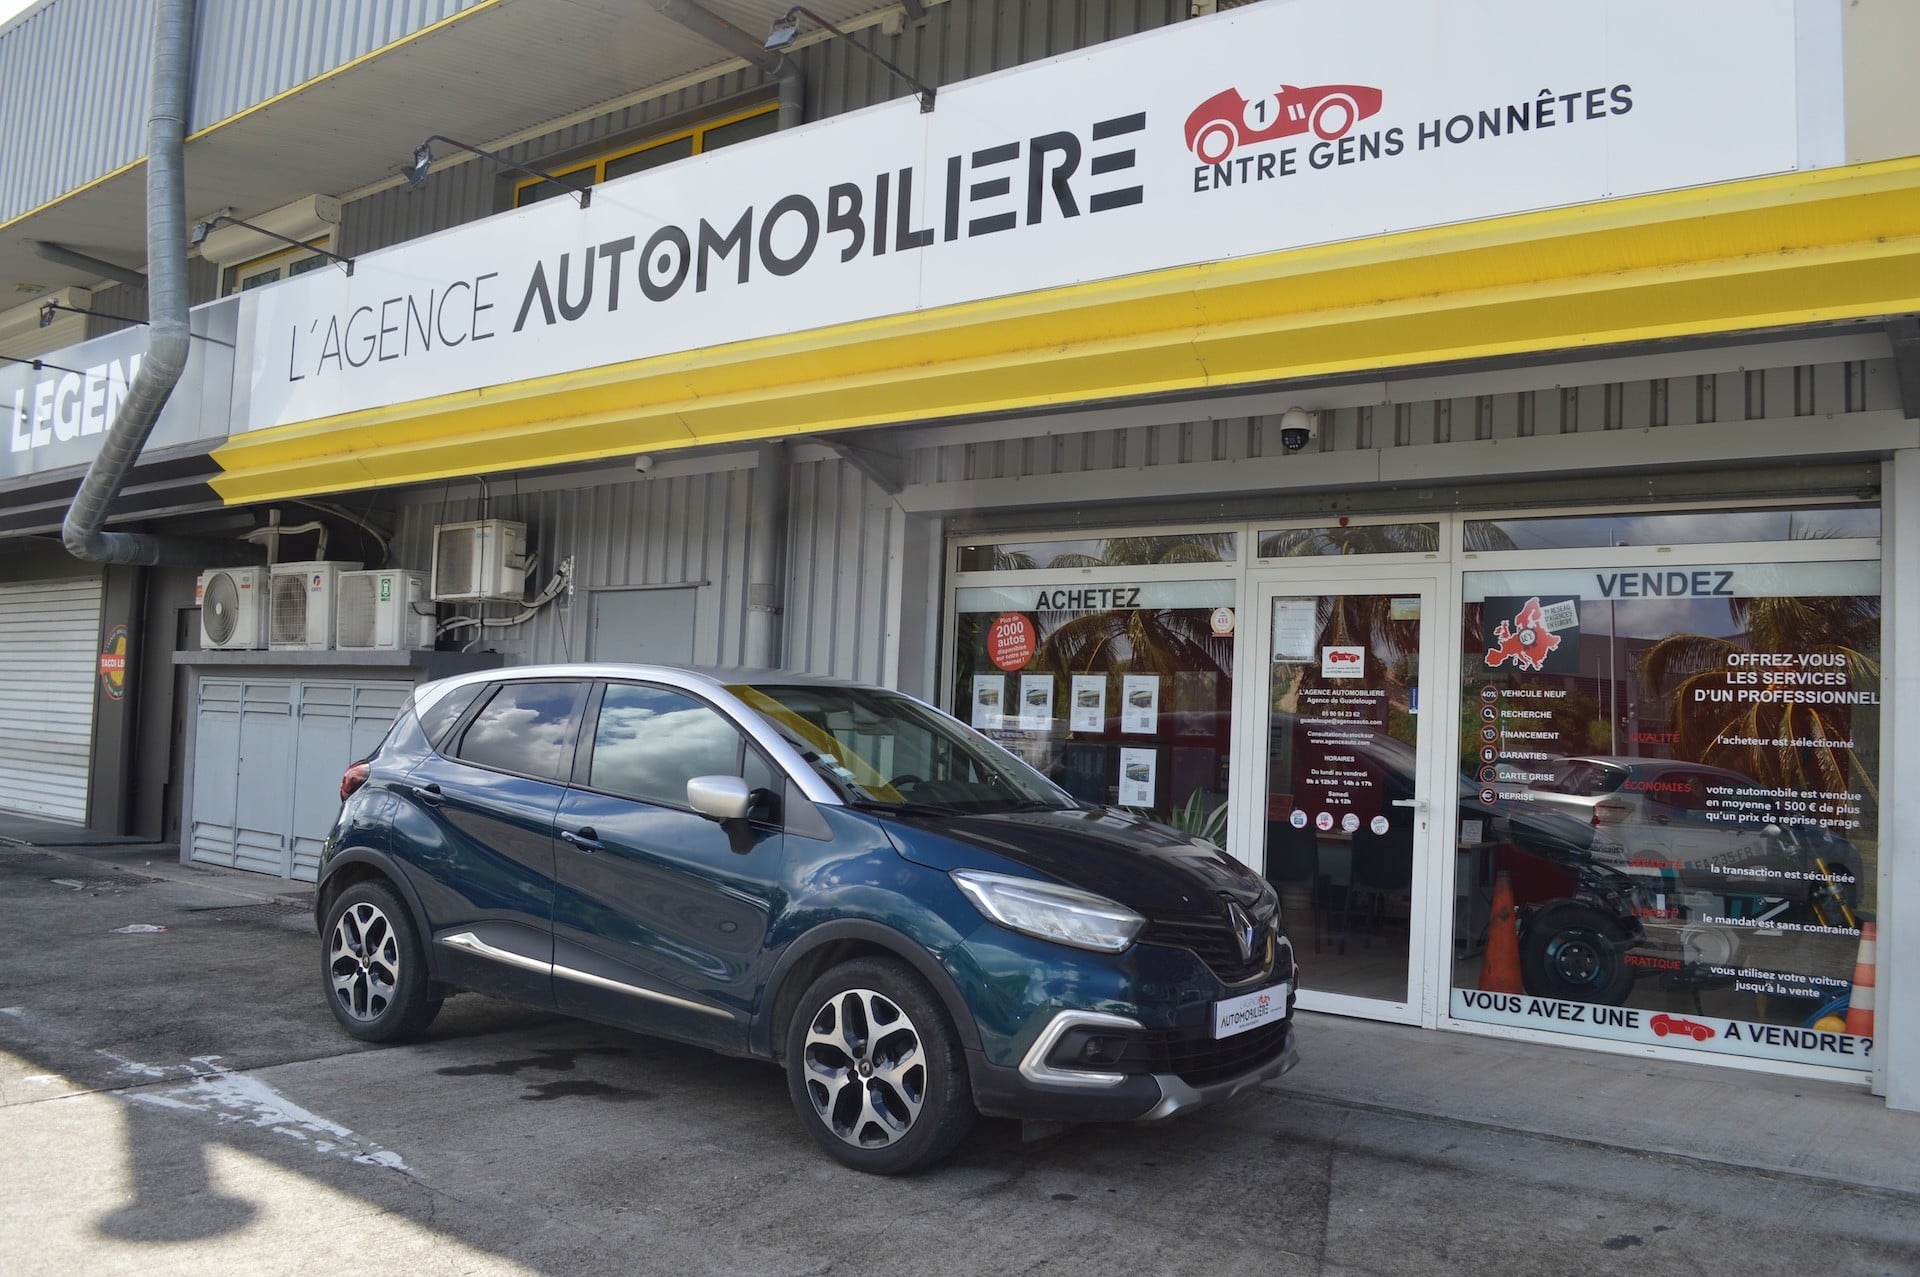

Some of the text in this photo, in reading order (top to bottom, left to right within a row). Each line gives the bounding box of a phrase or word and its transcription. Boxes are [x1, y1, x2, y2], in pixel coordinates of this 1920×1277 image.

[1194, 84, 1633, 192] ENTRE GENS HONNÊTES
[290, 112, 1146, 382] L'AGENCE AUTOMOBILIERE
[11, 352, 148, 452] LEGEN
[1596, 571, 1734, 597] VENDEZ
[1036, 588, 1141, 610] ACHETEZ
[996, 622, 1024, 638] 2000
[998, 635, 1025, 647] autos
[1728, 654, 1846, 666] OFFREZ-VOUS
[1727, 672, 1846, 686] LES SERVICES
[1501, 690, 1566, 698] VEHICULE NEUF
[1695, 690, 1880, 704] D'UN PROFESSIONNEL
[1501, 710, 1552, 718] RECHERCHE
[1718, 736, 1854, 748] l'acheteur est sélectionné
[1500, 752, 1548, 760] GARANTIES
[1500, 772, 1527, 780] CARTE
[1499, 792, 1534, 801] REPRISE
[1706, 786, 1862, 800] votre automobile est vendue
[1722, 800, 1771, 810] moyenne
[1775, 801, 1780, 810] 1
[1785, 802, 1806, 811] 500
[1809, 802, 1816, 812] €
[1819, 803, 1834, 813] de
[1836, 804, 1860, 815] plus
[1706, 812, 1859, 829] qu'un prix de reprise garage
[1711, 864, 1855, 883] la transaction est sécurisée
[1703, 913, 1860, 936] le mandat est sans contrainte
[1624, 955, 1680, 970] PRATIQUE
[1711, 966, 1848, 987] vous utilisez votre voiture
[1735, 980, 1820, 998] jusqu'à la vente
[1462, 990, 1640, 1028] VOUS AVEZ UNE
[1724, 1022, 1741, 1040] A
[1748, 1024, 1854, 1055] VENDRE
